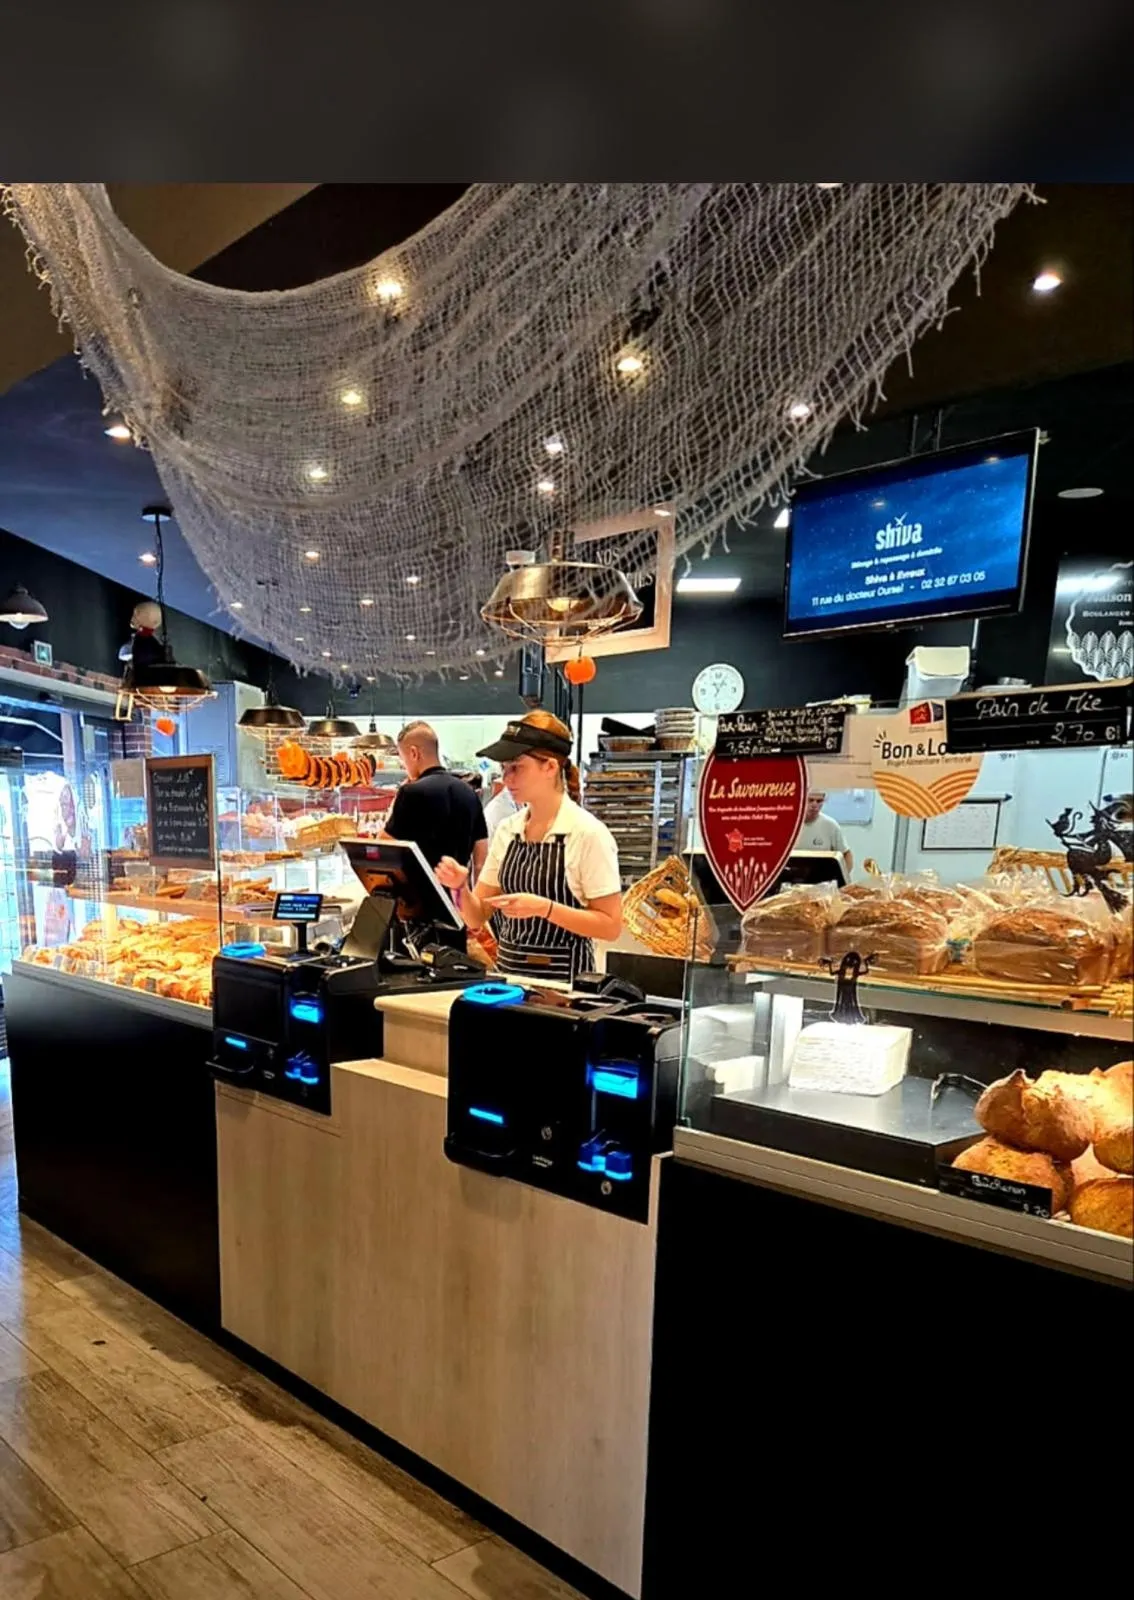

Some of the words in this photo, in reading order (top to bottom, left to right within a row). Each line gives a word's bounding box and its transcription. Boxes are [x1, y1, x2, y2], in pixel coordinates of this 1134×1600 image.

[875, 513, 923, 550] shiva
[819, 596, 833, 605] rue
[833, 593, 844, 603] du
[845, 589, 876, 601] docteur
[976, 696, 1020, 720] Pain
[1028, 694, 1049, 714] de
[1065, 691, 1105, 714] Mie
[1050, 722, 1096, 744] 2,70
[882, 742, 912, 760] Bon
[916, 743, 925, 755] &
[928, 738, 948, 756] Lo
[709, 778, 725, 799] La
[728, 777, 796, 799] Savoureuse
